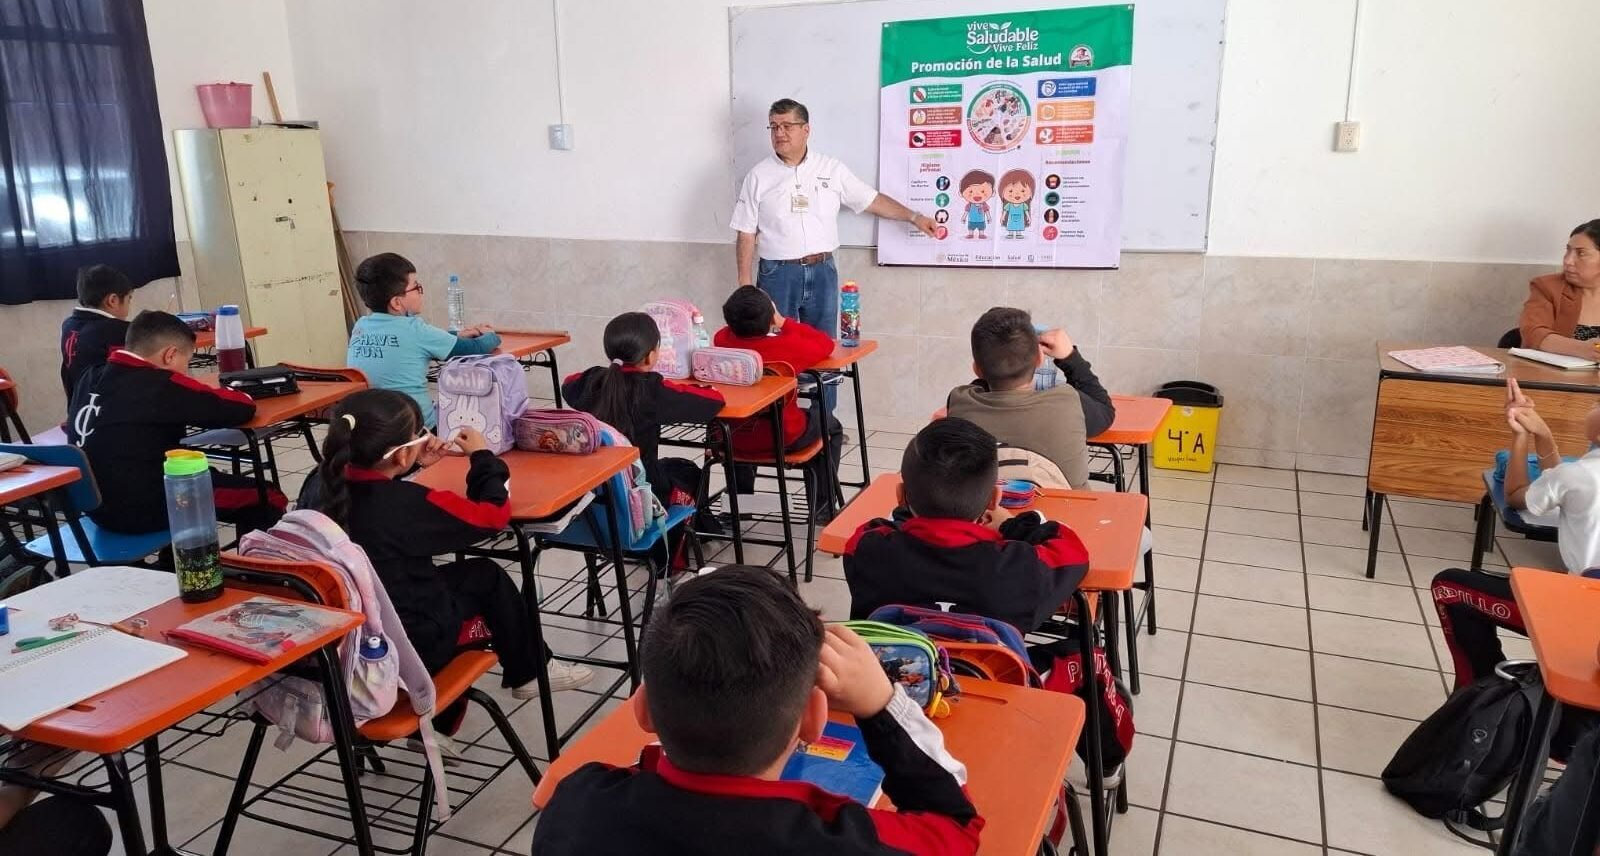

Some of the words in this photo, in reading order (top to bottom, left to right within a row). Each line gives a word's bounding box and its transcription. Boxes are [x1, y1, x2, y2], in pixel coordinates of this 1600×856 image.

[967, 28, 1039, 45] Saludable
[993, 43, 1013, 53] Vive
[1017, 41, 1038, 51] Feliz
[911, 58, 981, 73] Promoción
[986, 56, 1003, 69] de
[1006, 56, 1019, 68] la
[1022, 53, 1062, 67] Salud
[359, 335, 400, 347] HAVE
[352, 346, 384, 358] FUN
[447, 371, 490, 391] Milk
[1192, 432, 1205, 455] A
